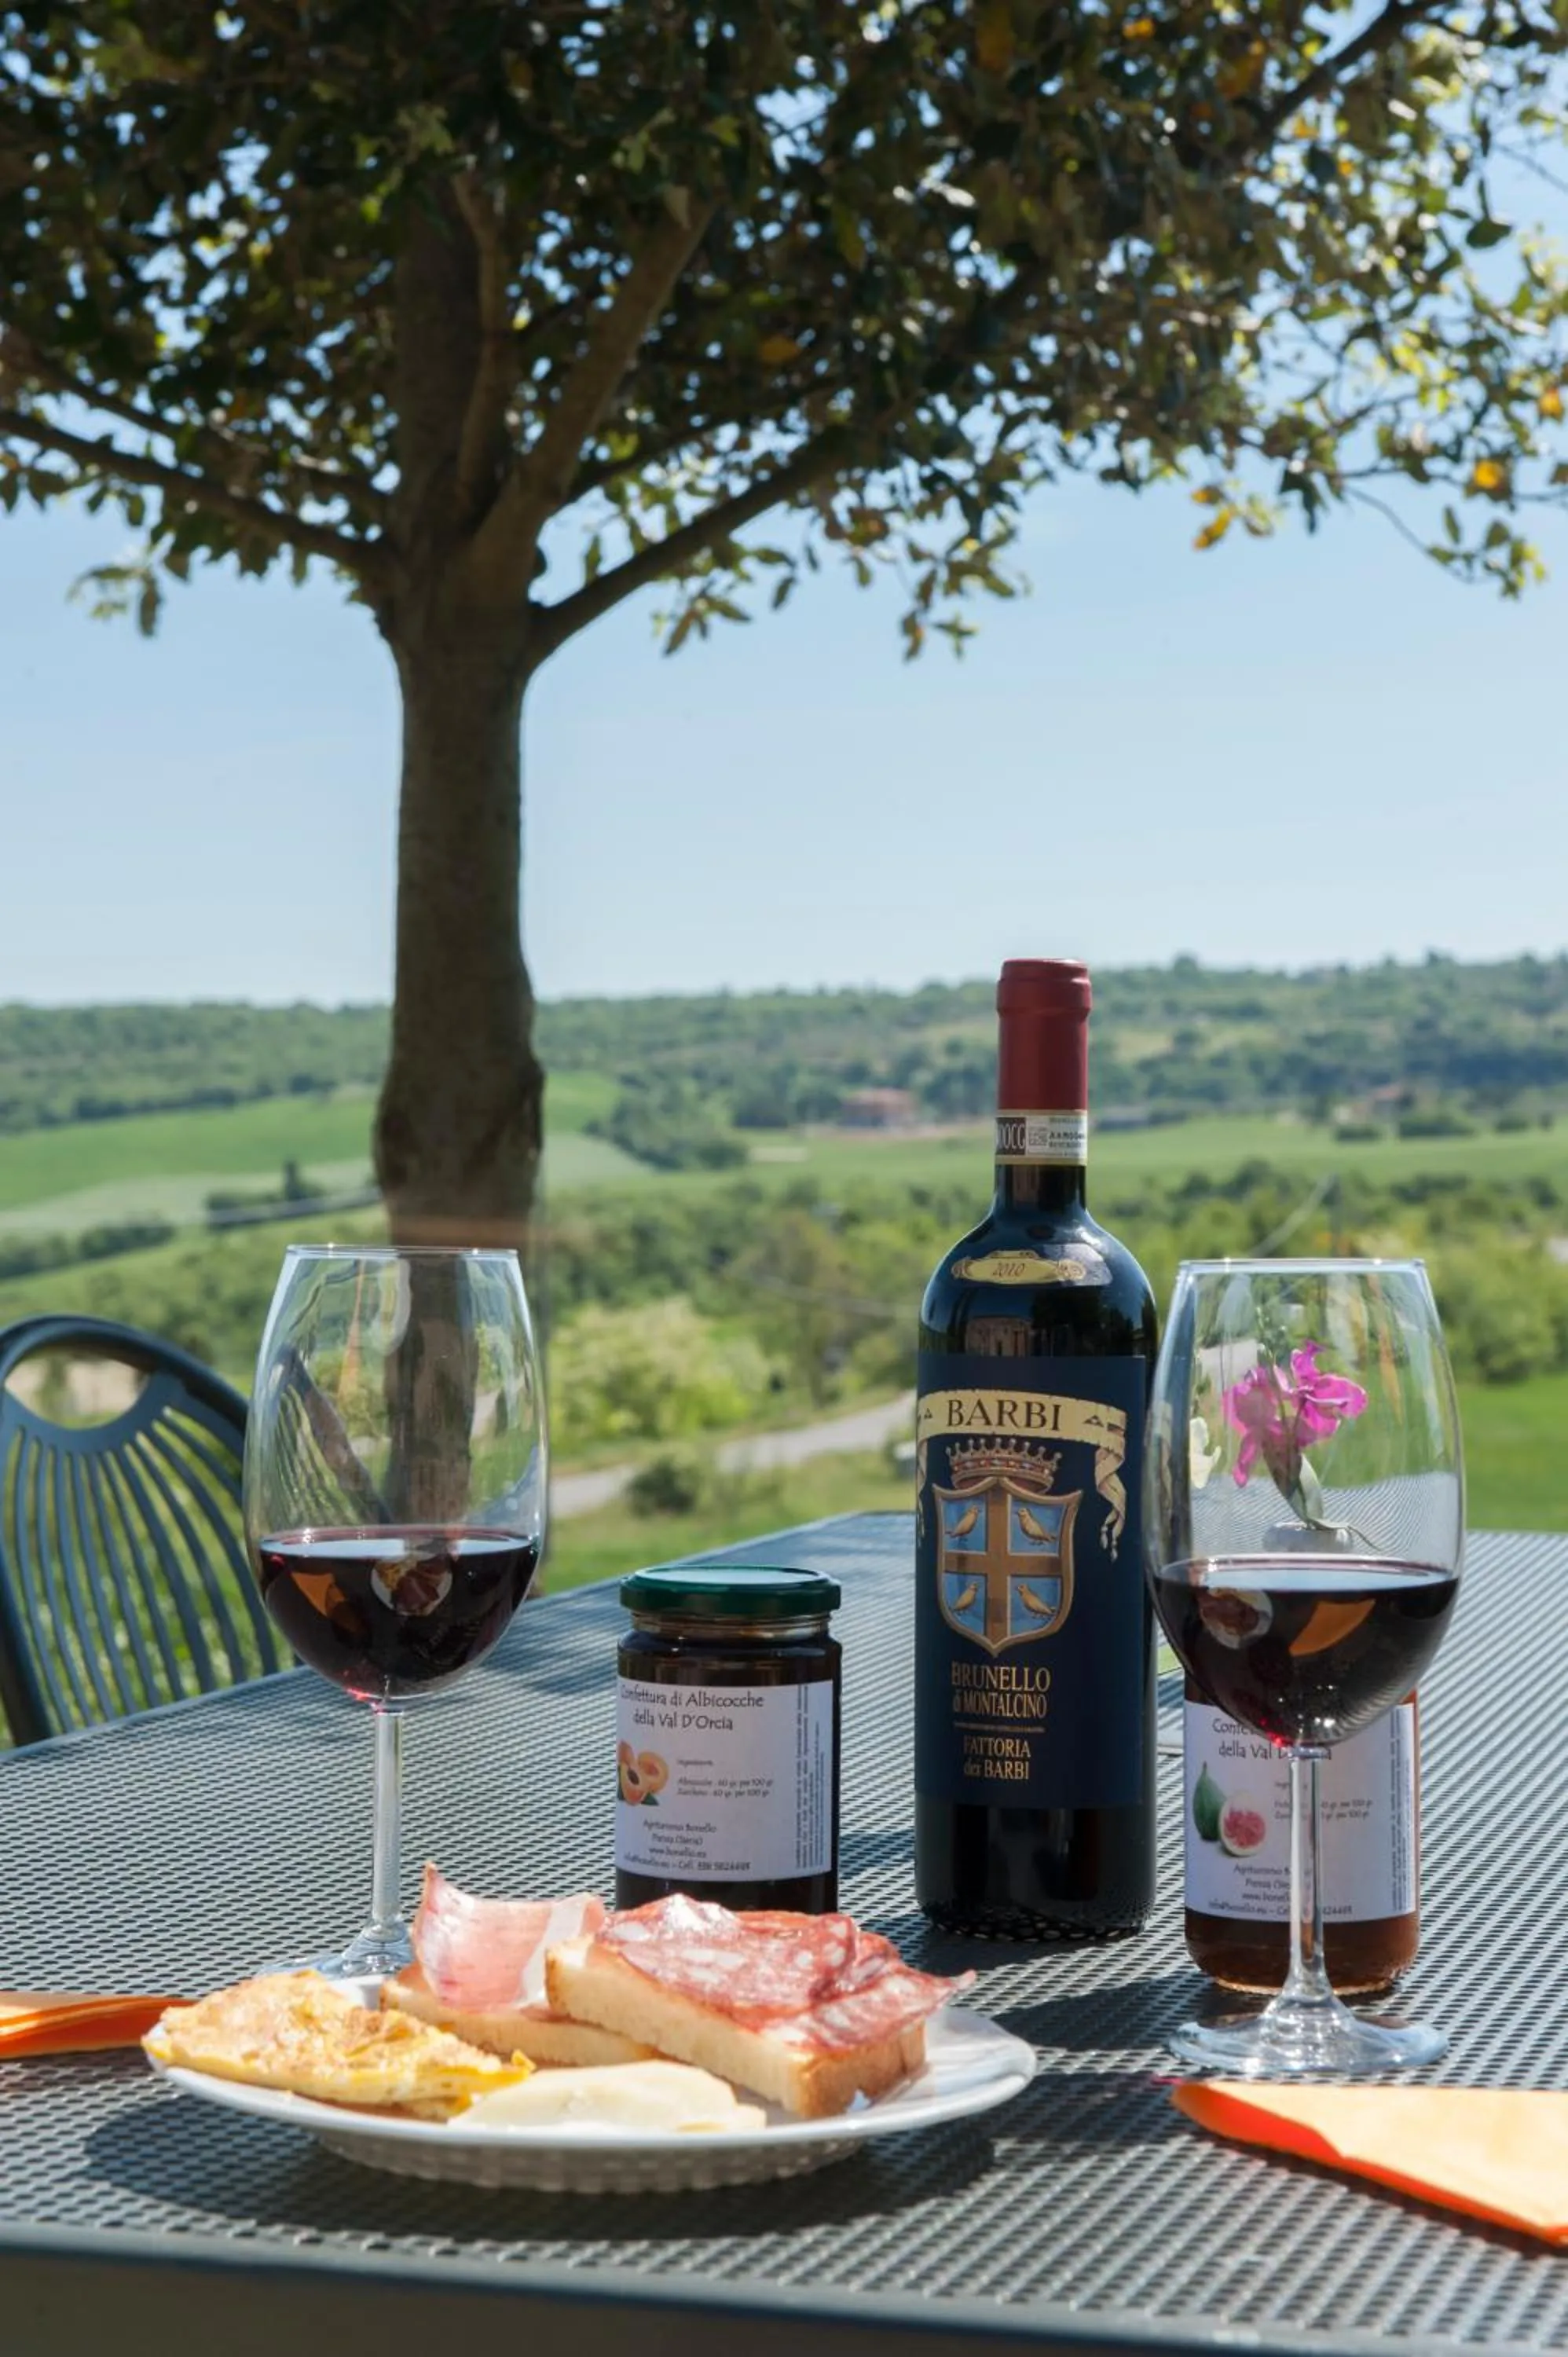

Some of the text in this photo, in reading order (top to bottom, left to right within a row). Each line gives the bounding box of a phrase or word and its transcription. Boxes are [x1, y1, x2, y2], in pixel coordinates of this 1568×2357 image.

[993, 1262, 1025, 1277] 2010
[947, 1398, 1061, 1431] BARBI
[951, 1661, 1050, 1692] BRUNELLO
[671, 1691, 682, 1707] di
[685, 1690, 765, 1708] Albicocche
[964, 1692, 1048, 1719] MONTALCINO
[633, 1709, 734, 1731] della Val D'Orcia
[964, 1736, 1031, 1758] FATTORIA
[1218, 1740, 1246, 1759] della
[1251, 1743, 1272, 1760] Val
[984, 1759, 1030, 1780] BARBI
